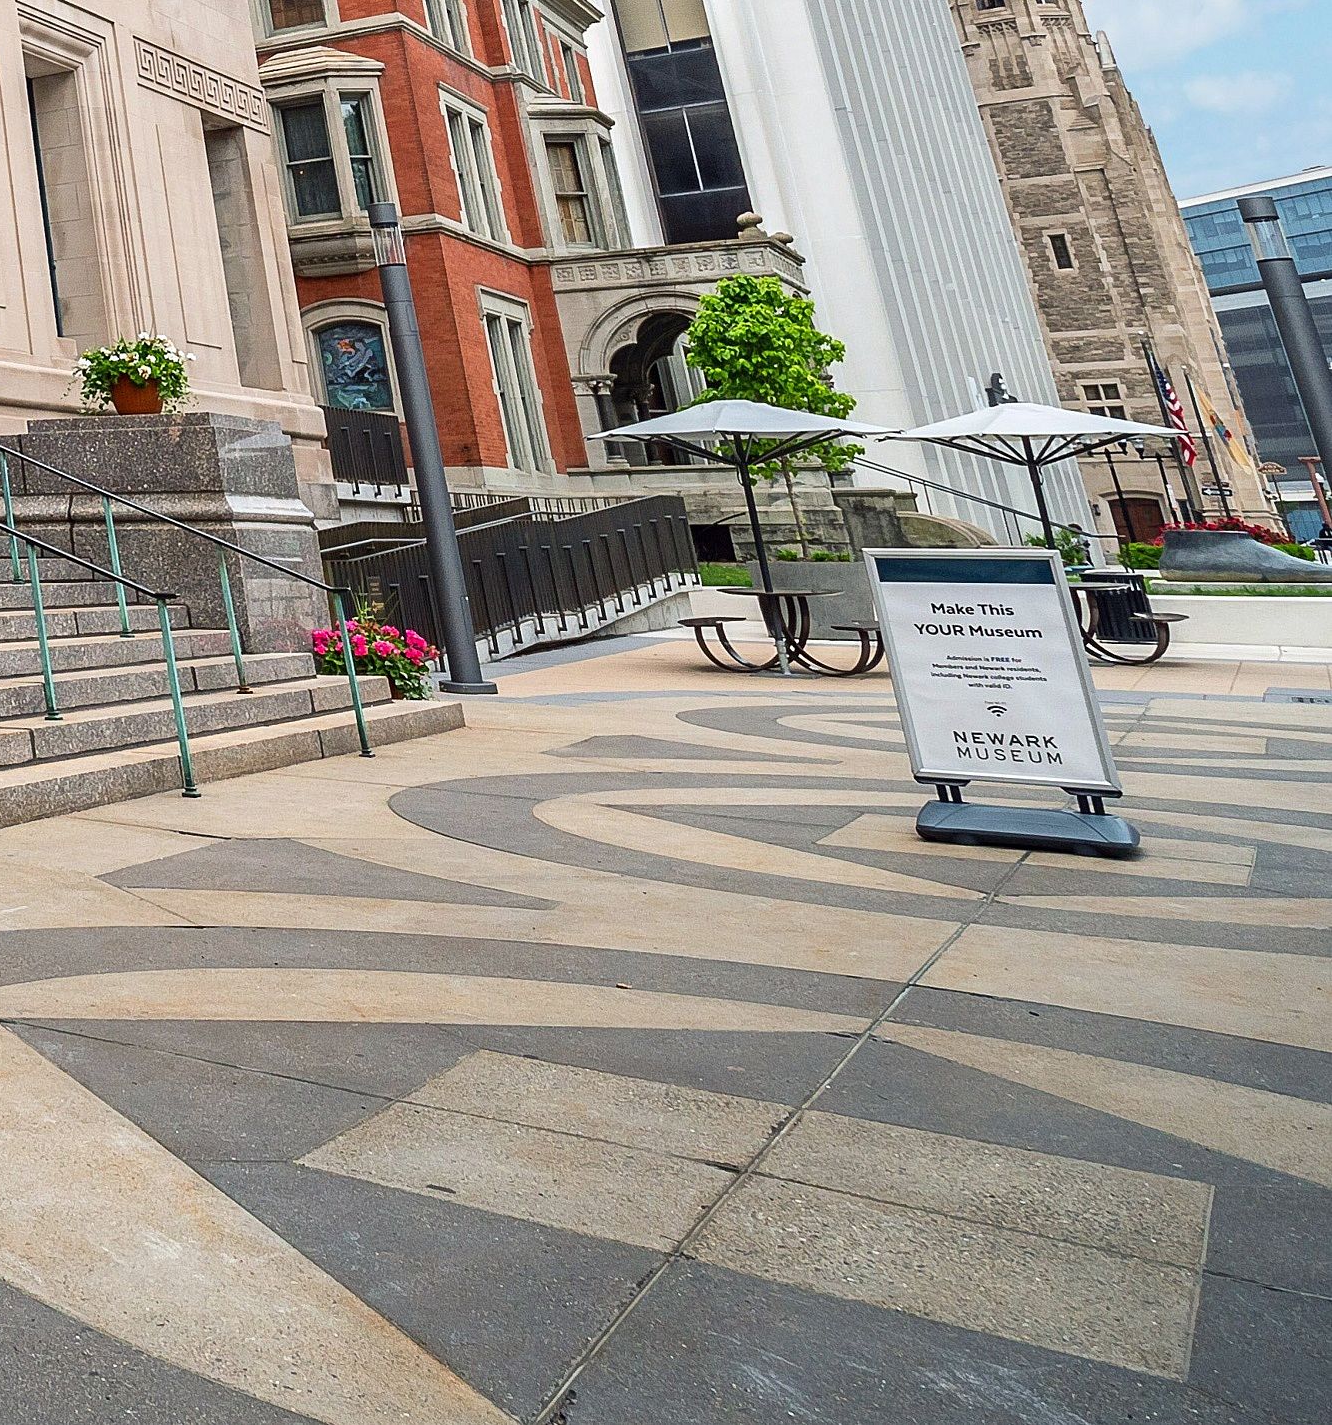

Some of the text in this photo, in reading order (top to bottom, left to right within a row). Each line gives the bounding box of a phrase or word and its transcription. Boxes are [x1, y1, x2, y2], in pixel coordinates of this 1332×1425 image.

[930, 602, 1015, 616] Make This
[913, 623, 1043, 638] YOUR Museum
[953, 730, 1058, 749] NEWARK
[956, 746, 1063, 765] MUSEUM
